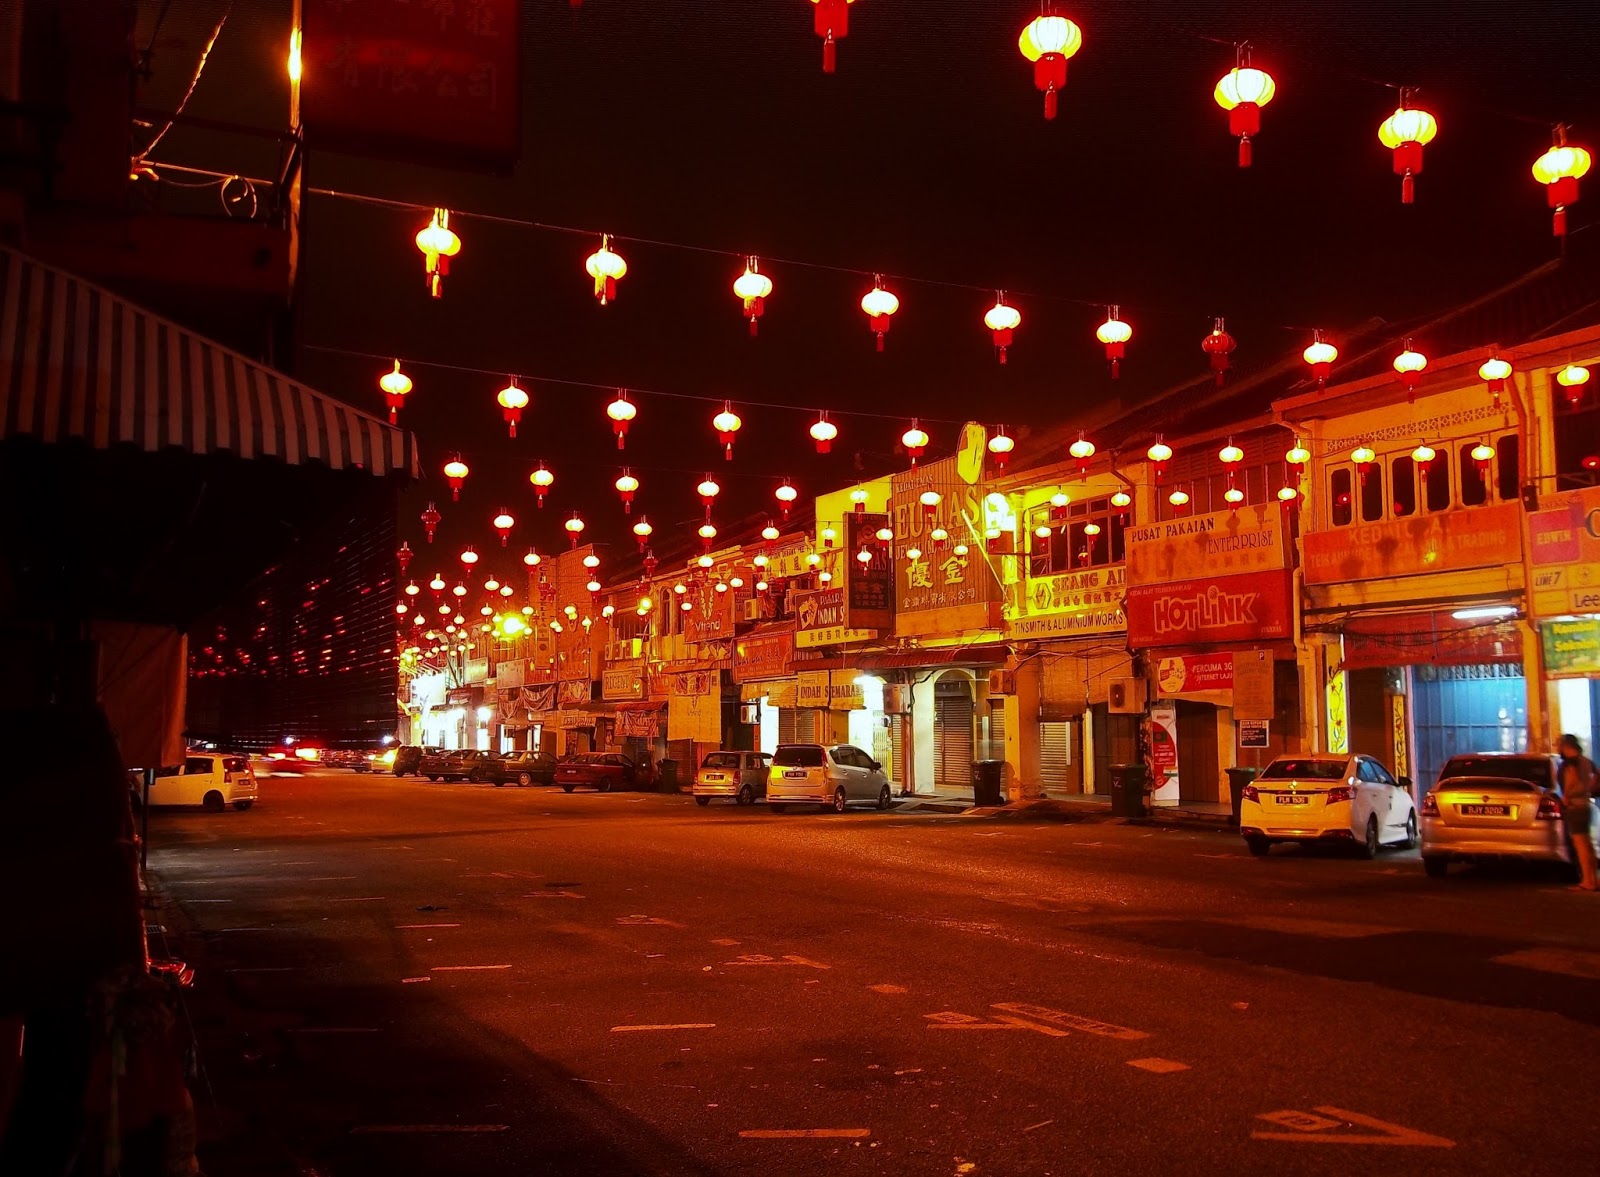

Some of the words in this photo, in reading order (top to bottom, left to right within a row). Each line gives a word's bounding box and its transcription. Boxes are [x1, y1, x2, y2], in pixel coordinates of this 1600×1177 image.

[1131, 527, 1161, 543] PUSAT
[1166, 517, 1215, 537] PAKAIAN
[1208, 530, 1274, 554] ENTERPRISE
[1052, 572, 1099, 592] SEANG
[1574, 593, 1600, 608] Lee
[1015, 620, 1045, 634] TINSMITH
[1047, 619, 1052, 631] &
[1053, 615, 1094, 630] ALUMINIUM
[1095, 612, 1123, 627] WORKS
[1191, 663, 1222, 673] PERCUMA
[800, 686, 821, 699] INDAH
